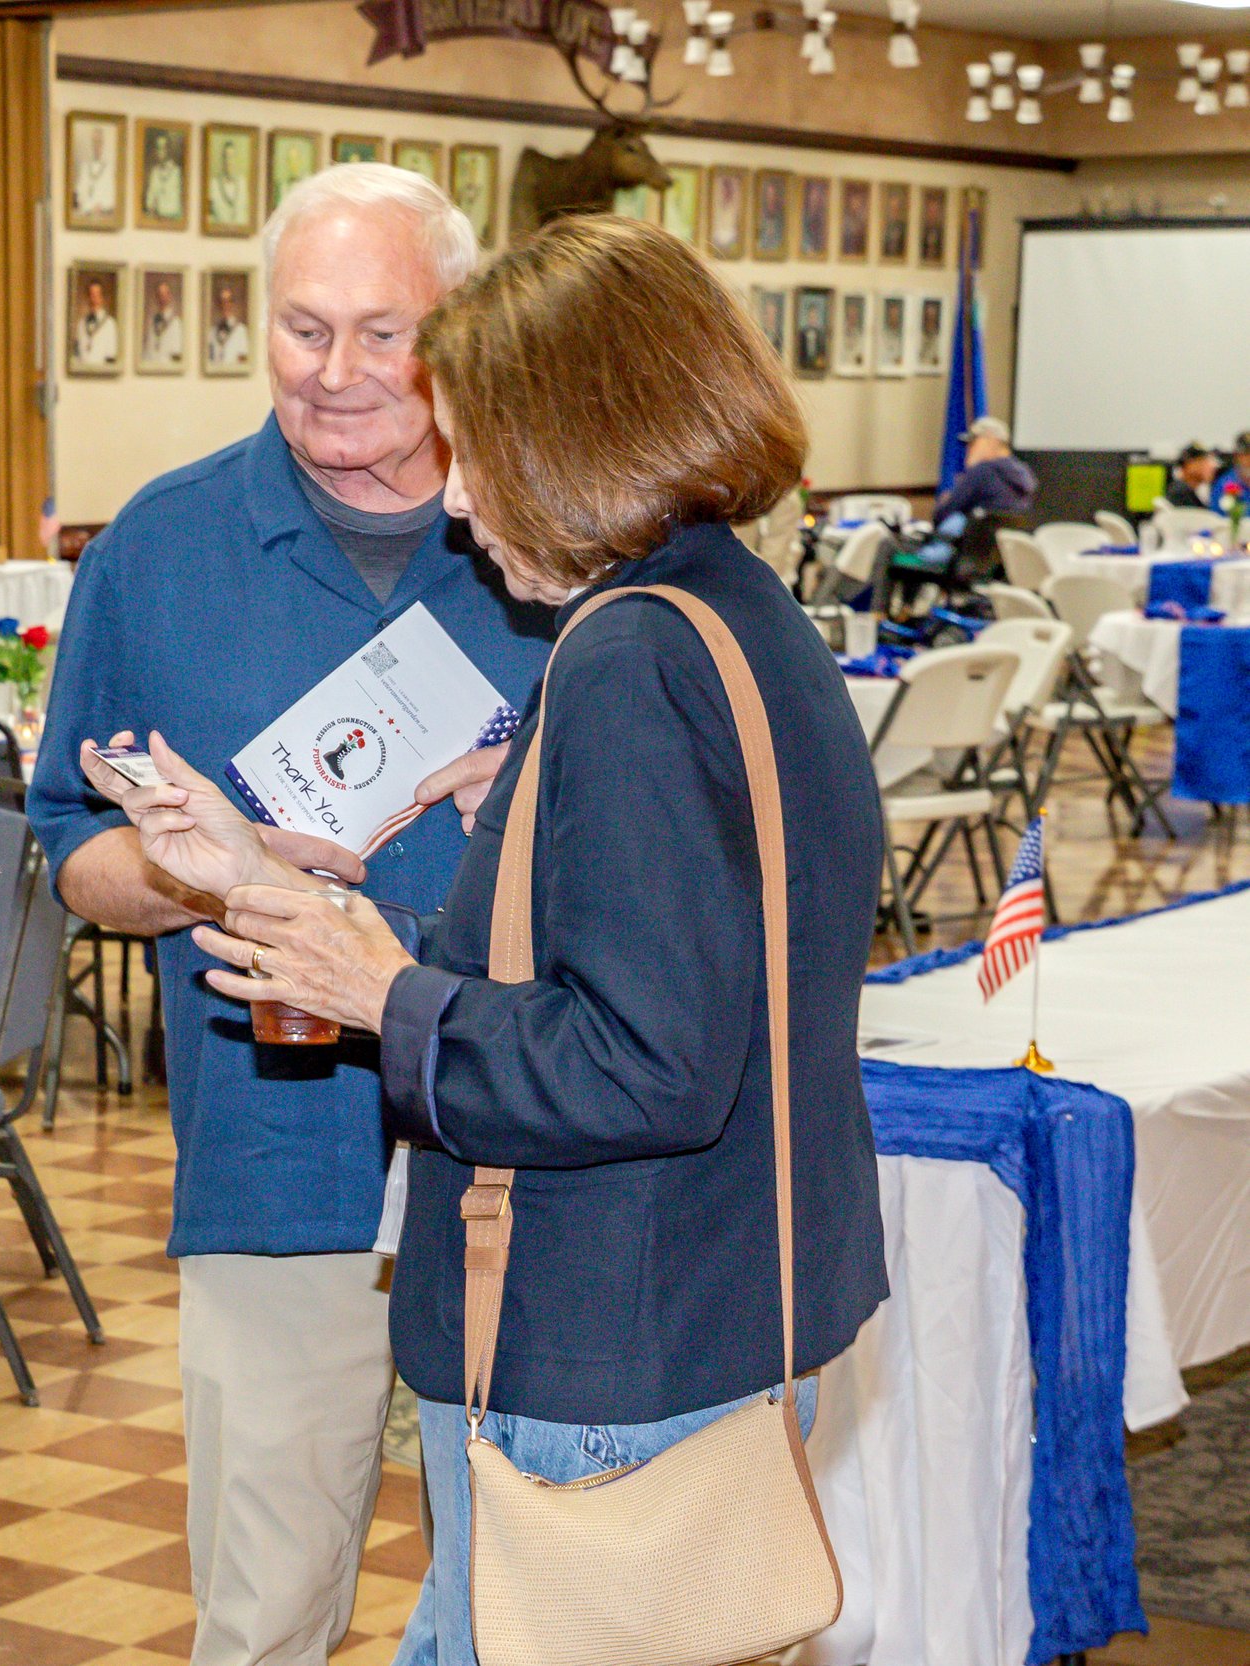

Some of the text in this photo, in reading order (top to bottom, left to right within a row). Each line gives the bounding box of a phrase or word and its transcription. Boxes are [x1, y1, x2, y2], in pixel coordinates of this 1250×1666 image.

[315, 717, 378, 742] MISSION CONNECTION
[312, 748, 347, 791] FUNDRAISER
[353, 735, 387, 790] VETERANS ART GARDEN
[271, 740, 345, 835] Thank You
[295, 799, 317, 823] SUPPORT
